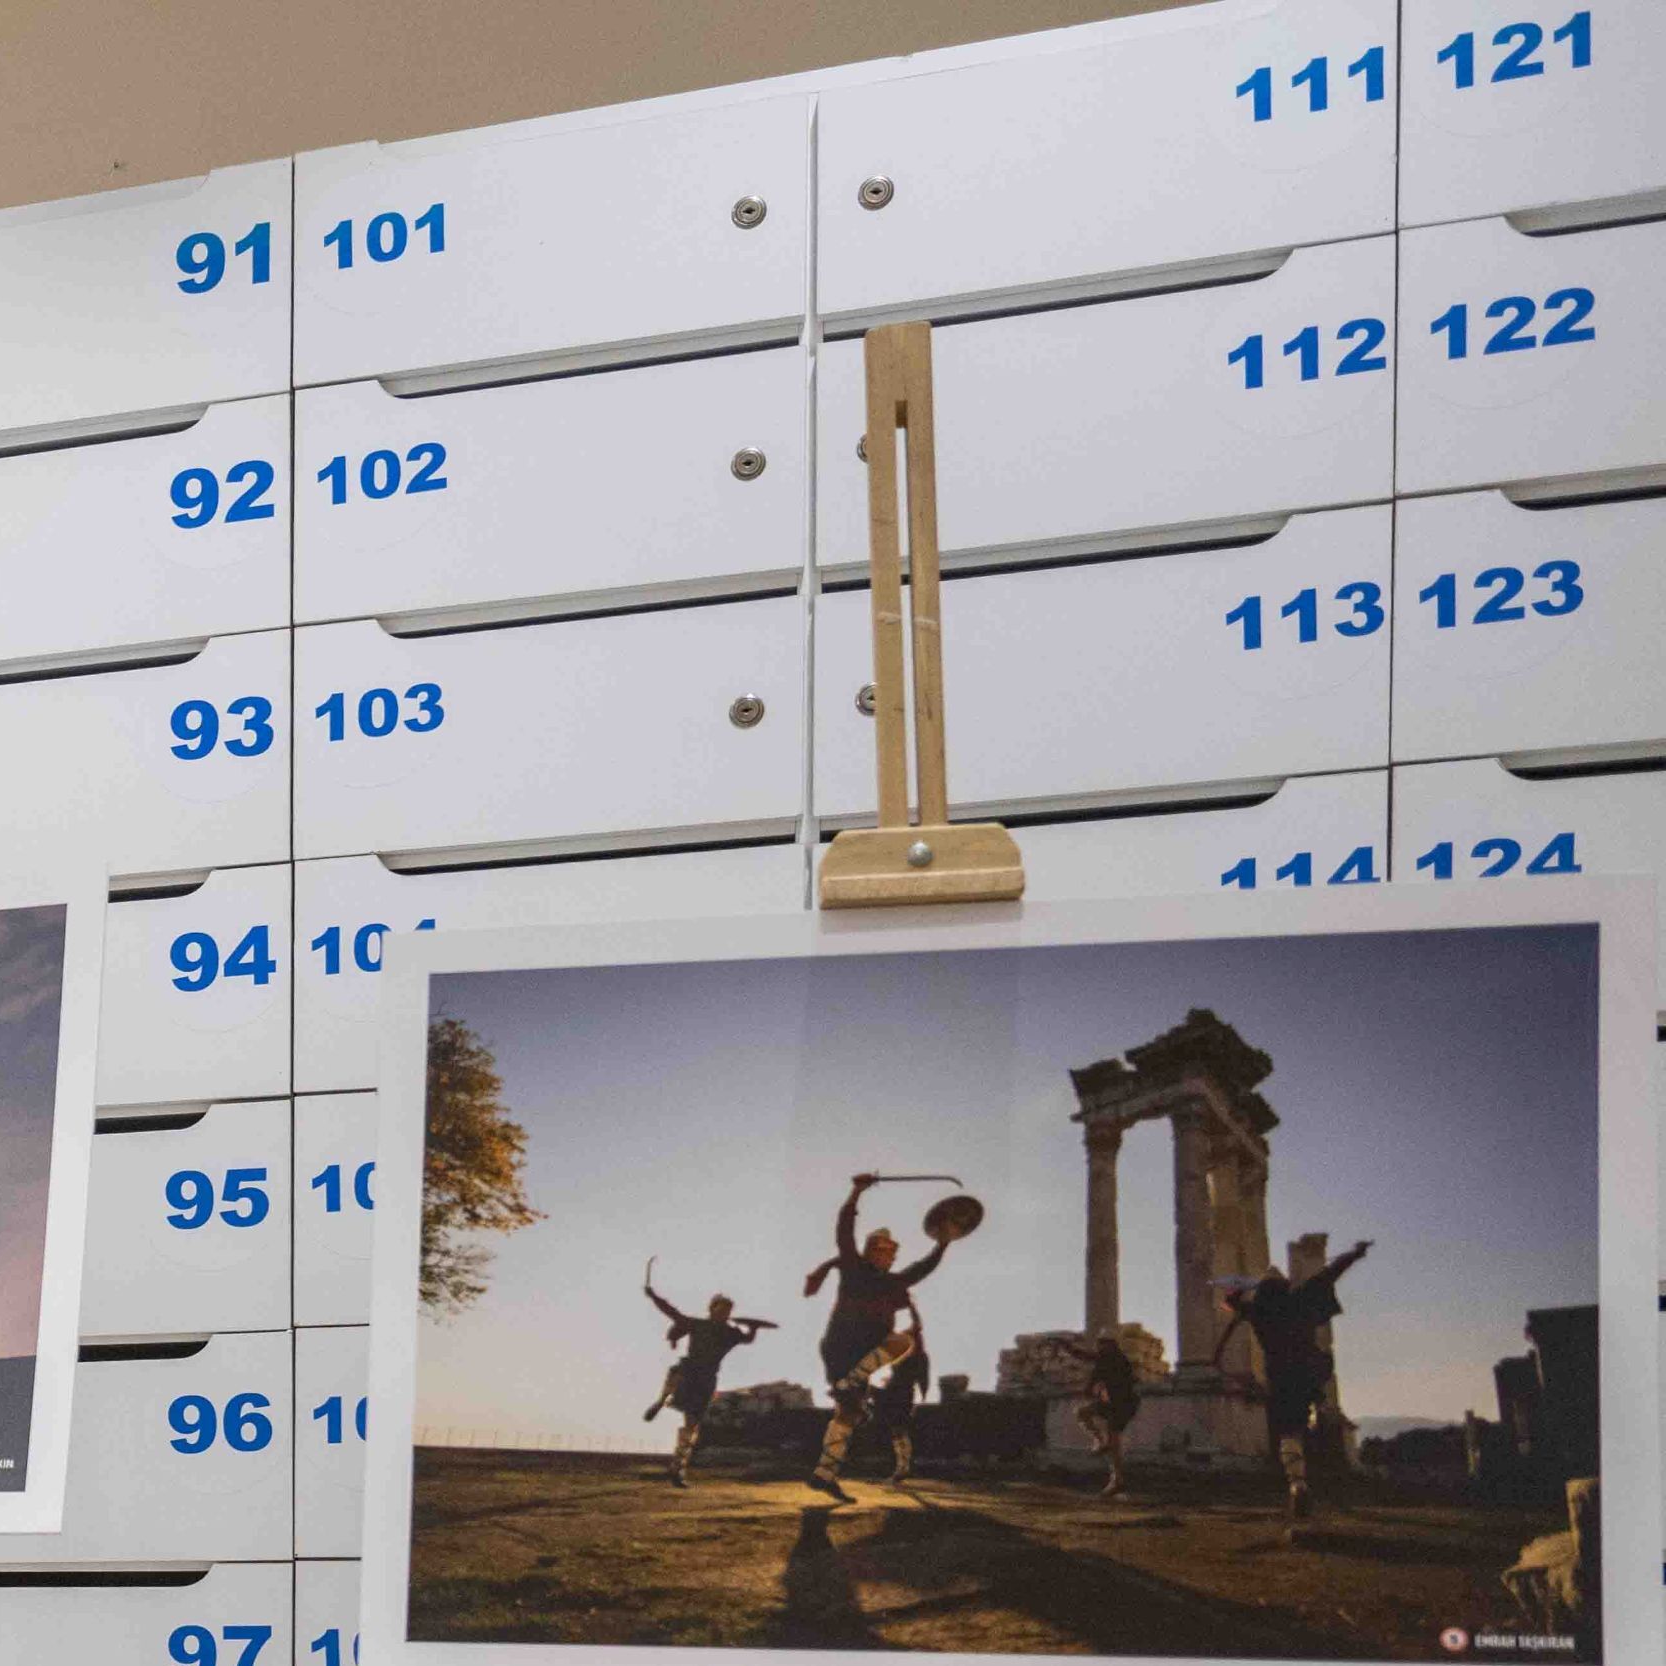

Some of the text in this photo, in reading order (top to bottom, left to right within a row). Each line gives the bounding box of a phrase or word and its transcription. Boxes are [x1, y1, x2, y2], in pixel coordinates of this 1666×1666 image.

[1437, 11, 1592, 89] 121
[1236, 47, 1386, 122] 111
[175, 222, 271, 294] 91
[323, 203, 446, 269] 101
[1227, 318, 1387, 389] 112
[1429, 287, 1596, 359] 122
[169, 460, 275, 529] 92
[317, 442, 448, 505] 102
[1225, 582, 1385, 650] 113
[1418, 559, 1585, 628] 123
[169, 696, 274, 761] 93
[315, 683, 445, 742] 103
[169, 925, 277, 992] 94
[164, 1167, 270, 1230] 95
[311, 1162, 376, 1213] 10
[167, 1392, 273, 1454] 96
